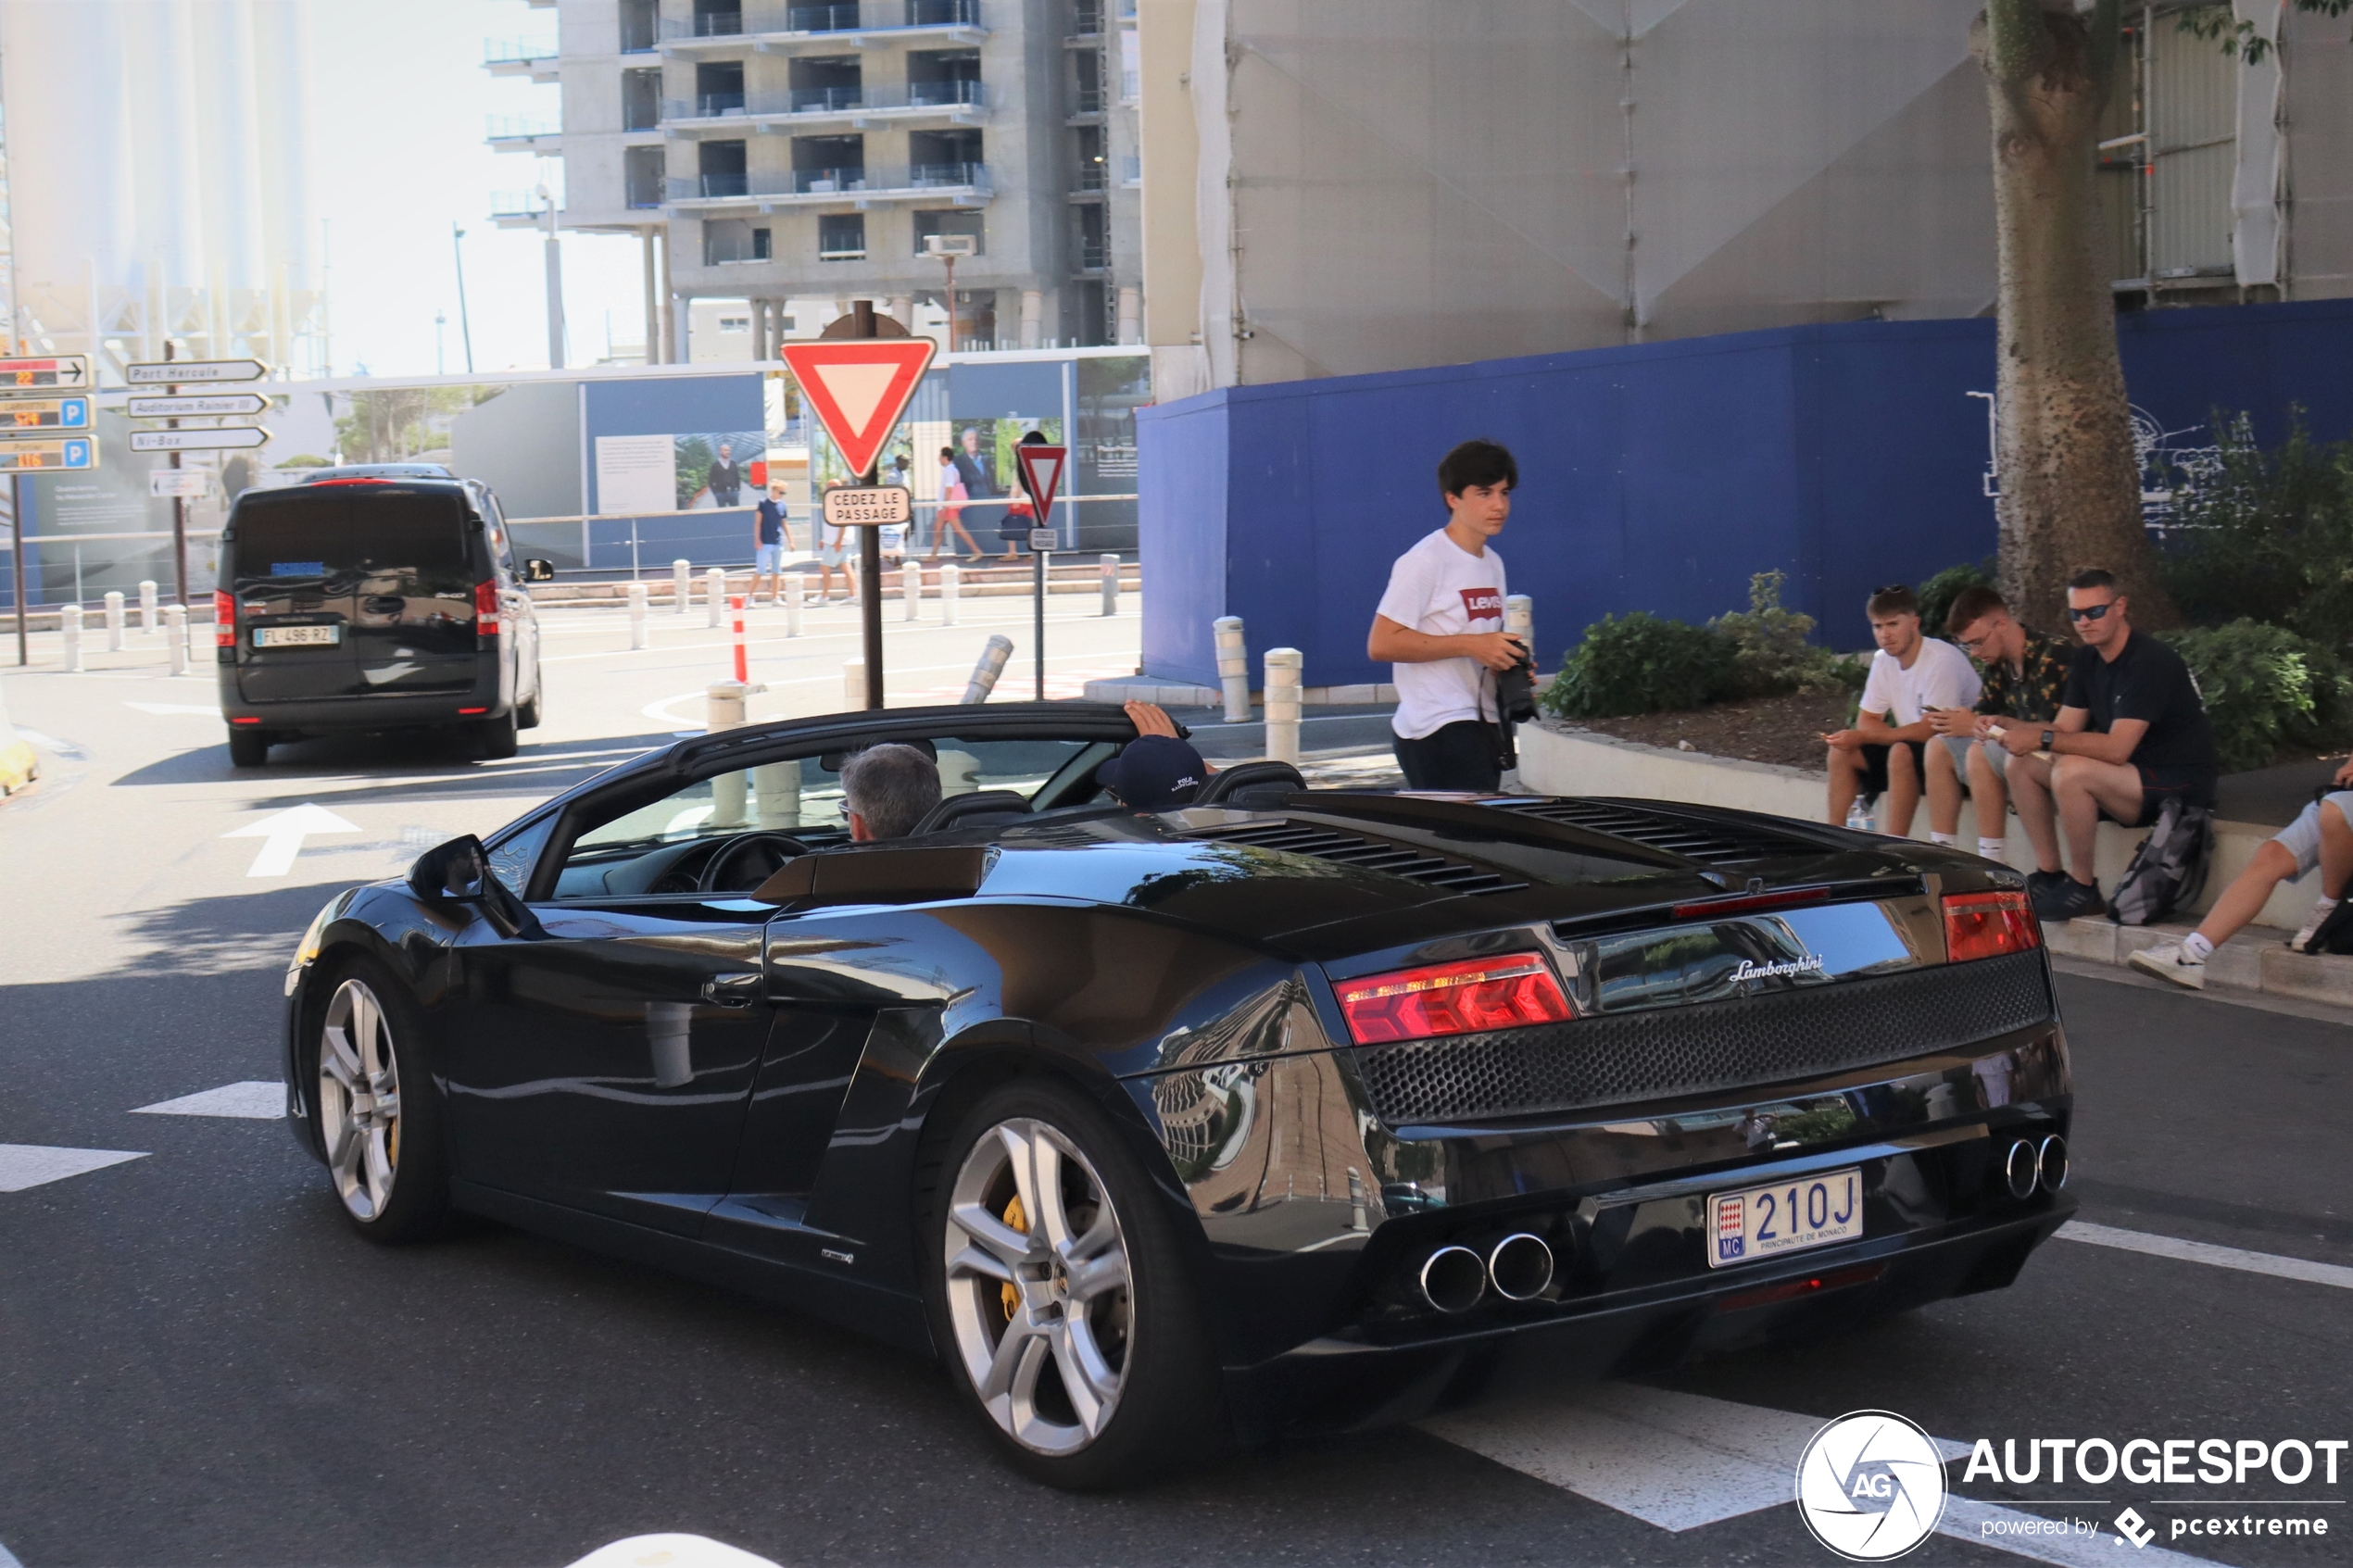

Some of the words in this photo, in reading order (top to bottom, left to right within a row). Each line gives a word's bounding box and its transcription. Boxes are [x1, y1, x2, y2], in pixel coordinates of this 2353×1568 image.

[132, 369, 161, 380] Port
[168, 367, 219, 379] Hercule
[135, 401, 194, 413] Auditorium
[197, 400, 234, 410] Rainier
[136, 435, 182, 446] Ni-Box
[834, 492, 876, 506] CÉDEZ
[884, 493, 899, 504] LE
[837, 508, 898, 521] PASSAGE
[1177, 777, 1193, 785] POLO
[1730, 954, 1824, 982] Lamborghini
[1755, 1177, 1853, 1241] 210J
[1806, 1231, 1816, 1240] DE
[1818, 1226, 1847, 1238] MONACO
[1723, 1238, 1740, 1256] MC
